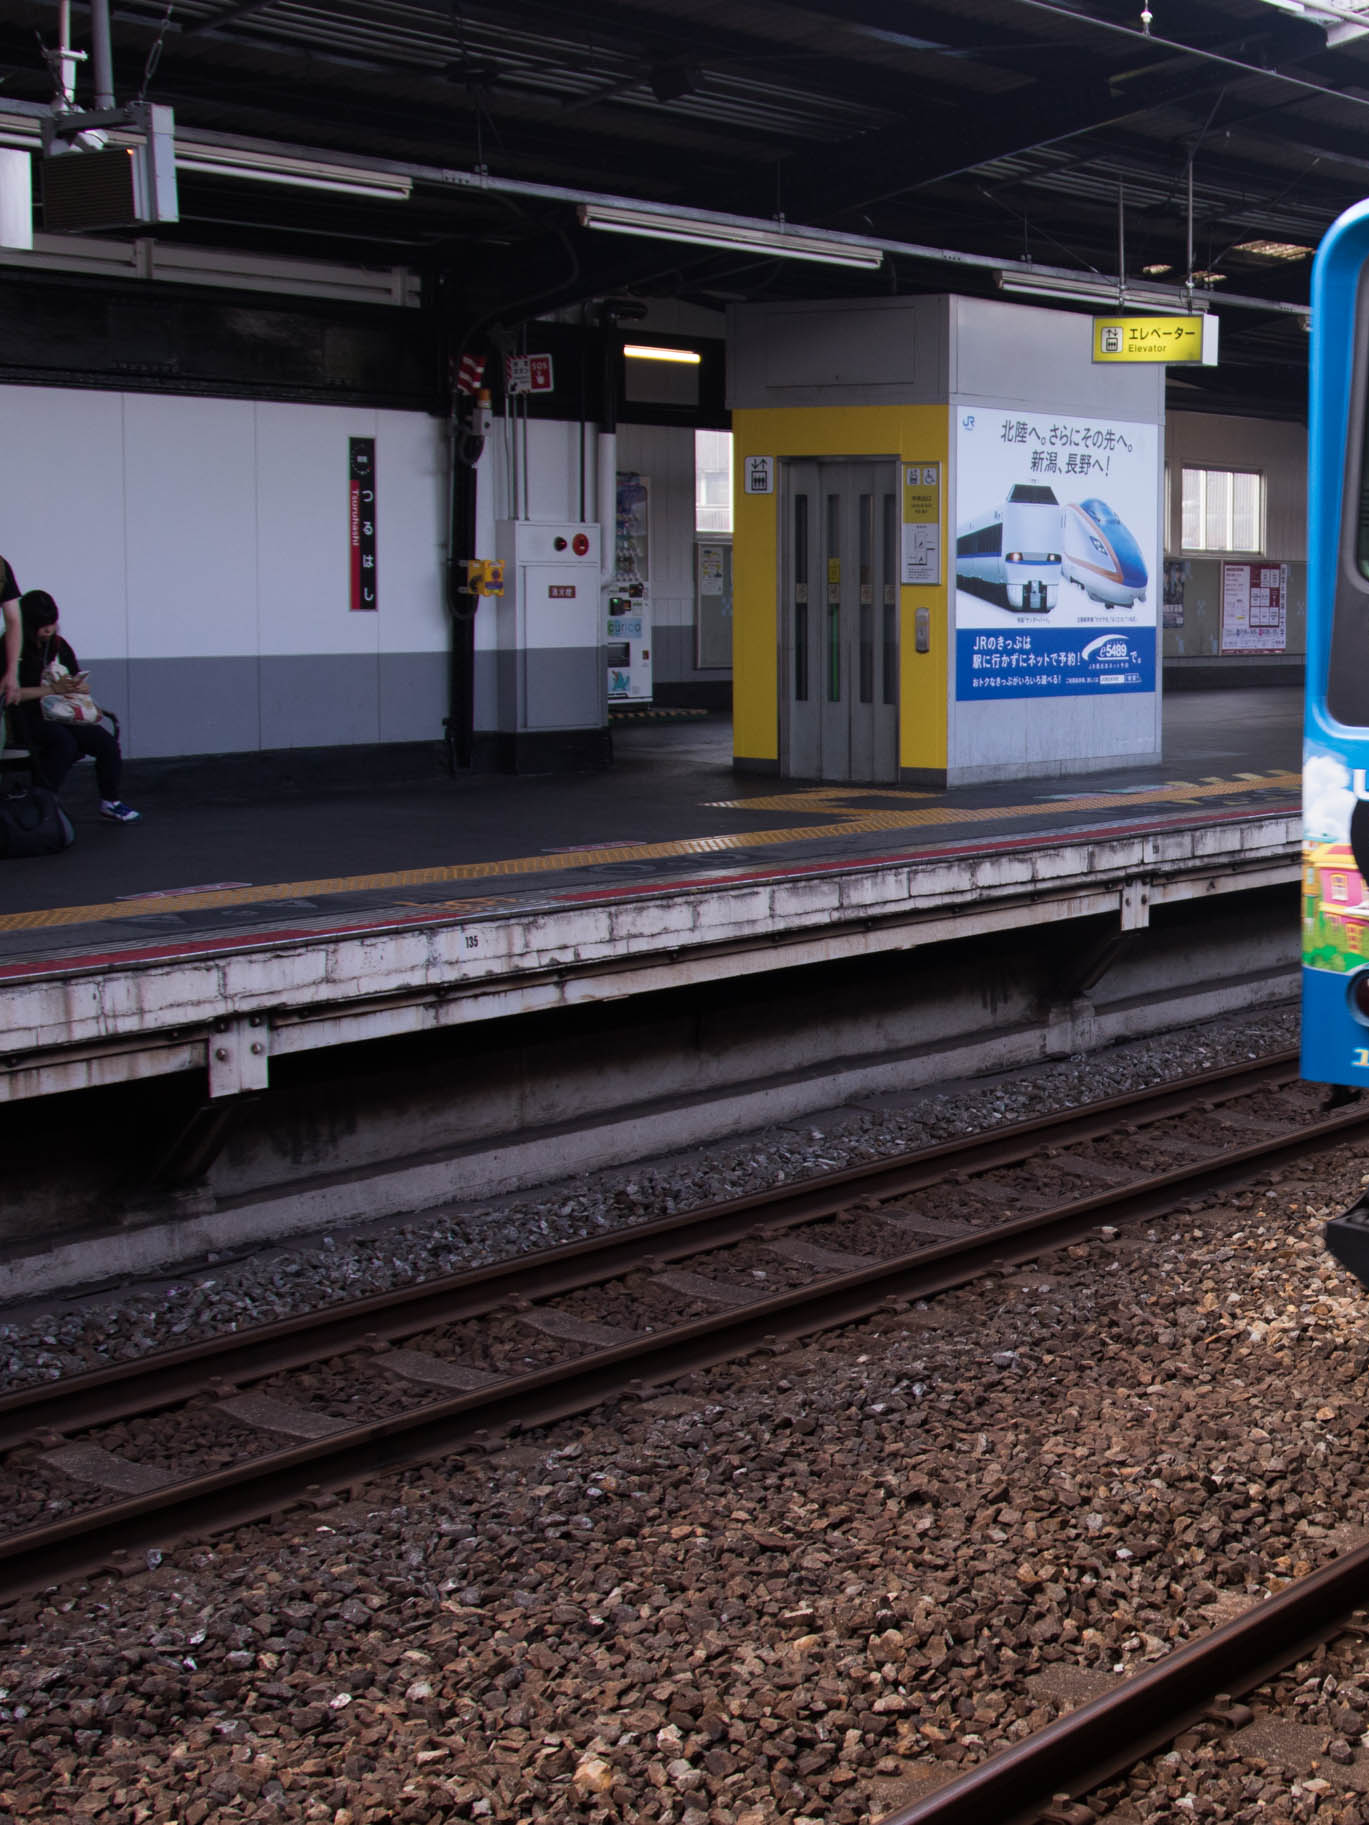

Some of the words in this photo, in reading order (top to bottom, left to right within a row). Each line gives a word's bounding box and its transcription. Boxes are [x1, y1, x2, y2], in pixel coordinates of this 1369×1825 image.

[1128, 326, 1197, 341] エレベーター
[1127, 343, 1168, 353] Elevator
[961, 415, 976, 428] JR
[1000, 418, 1134, 453] 北陸へ。さらにその先へ。
[1030, 449, 1112, 477] 新潟、長野へ！
[351, 488, 361, 547] Tsuruhashi
[361, 489, 375, 601] つるはし
[972, 635, 1032, 650] JRのきっぷは
[1099, 643, 1128, 658] e5489
[971, 651, 1082, 670] 駅に行かずにネットで予約！
[465, 935, 479, 949] 135
